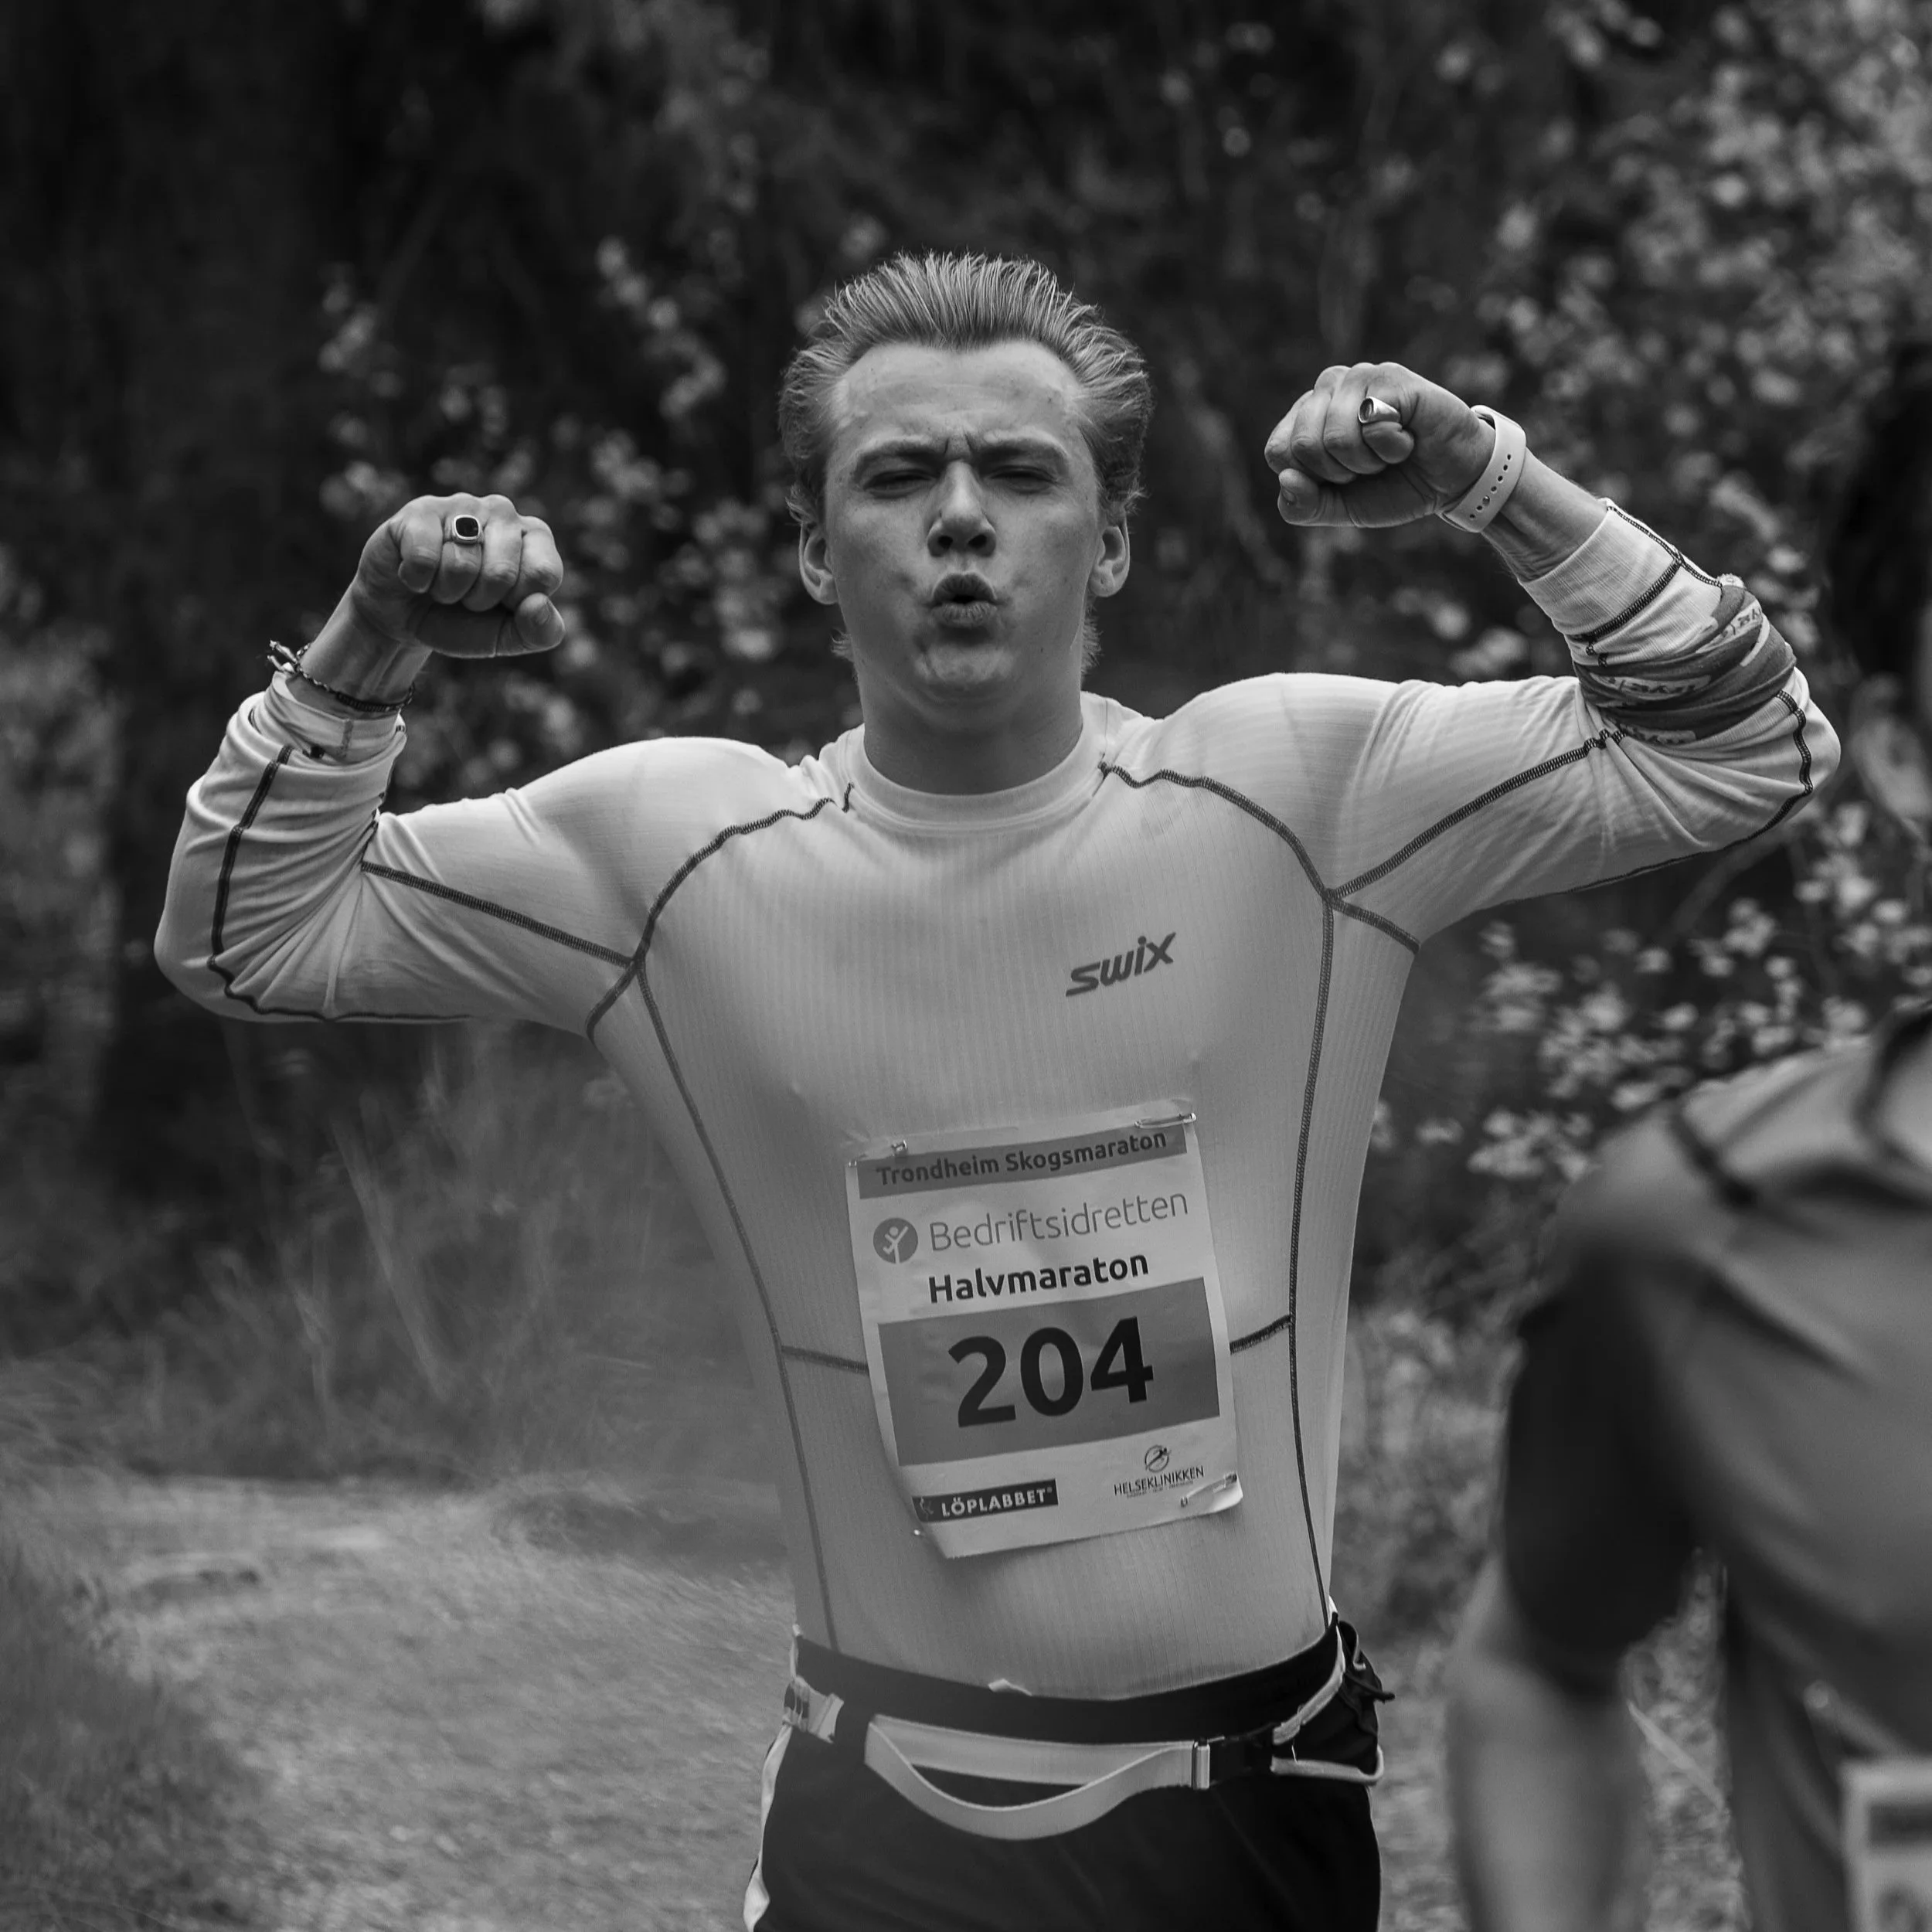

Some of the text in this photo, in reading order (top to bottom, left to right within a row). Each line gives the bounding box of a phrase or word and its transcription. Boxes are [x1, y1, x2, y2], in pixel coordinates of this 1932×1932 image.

[876, 1131, 1167, 1185] Trondheim Skogsmaraton
[930, 1192, 1189, 1251] Bedriftsidretten
[929, 1253, 1149, 1304] Halvmaraton
[948, 1316, 1154, 1427] 204
[1114, 1465, 1204, 1496] HELSEKLINIKKEN
